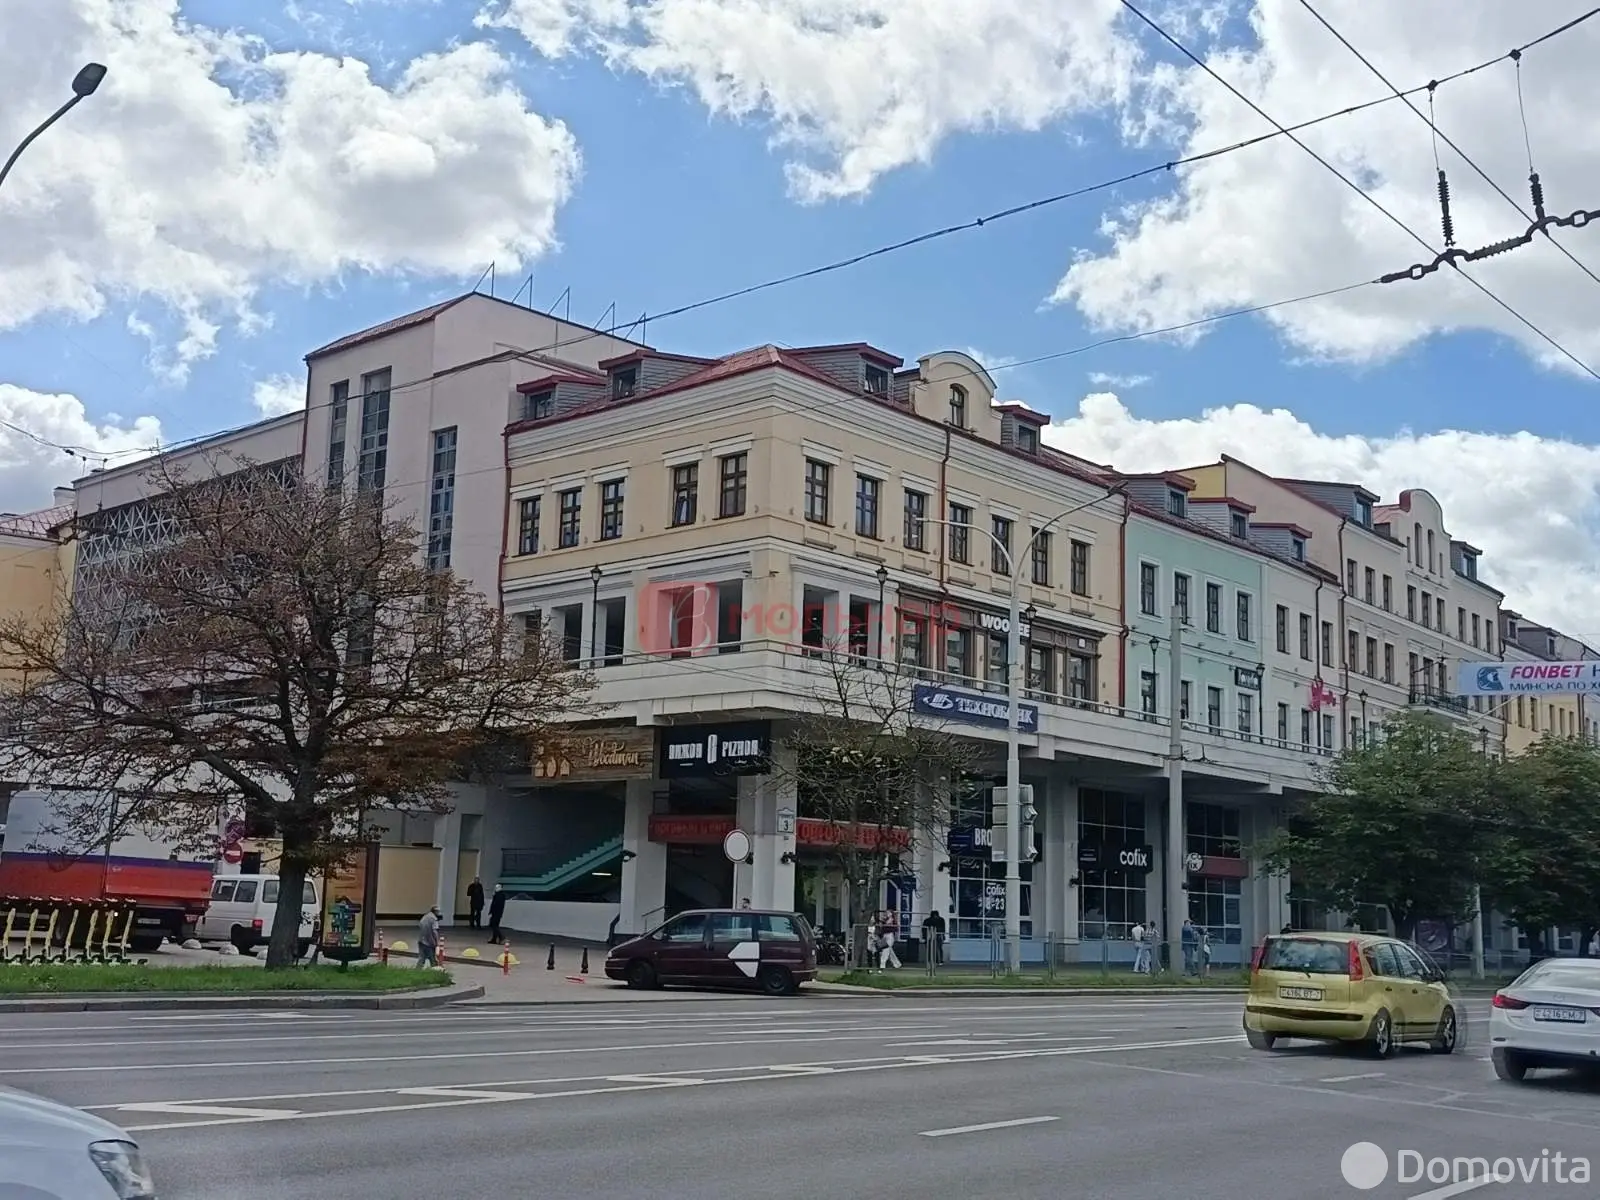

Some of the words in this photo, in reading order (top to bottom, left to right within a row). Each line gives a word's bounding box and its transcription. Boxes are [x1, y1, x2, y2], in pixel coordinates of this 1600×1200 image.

[980, 613, 1030, 637] WOOEE
[1511, 665, 1585, 679] FONBET
[1509, 682, 1562, 691] МИНСКА
[1568, 682, 1585, 690] ПО
[956, 698, 1033, 724] ТЕХНОБНК
[783, 819, 789, 831] 3
[1119, 848, 1148, 867] cofix
